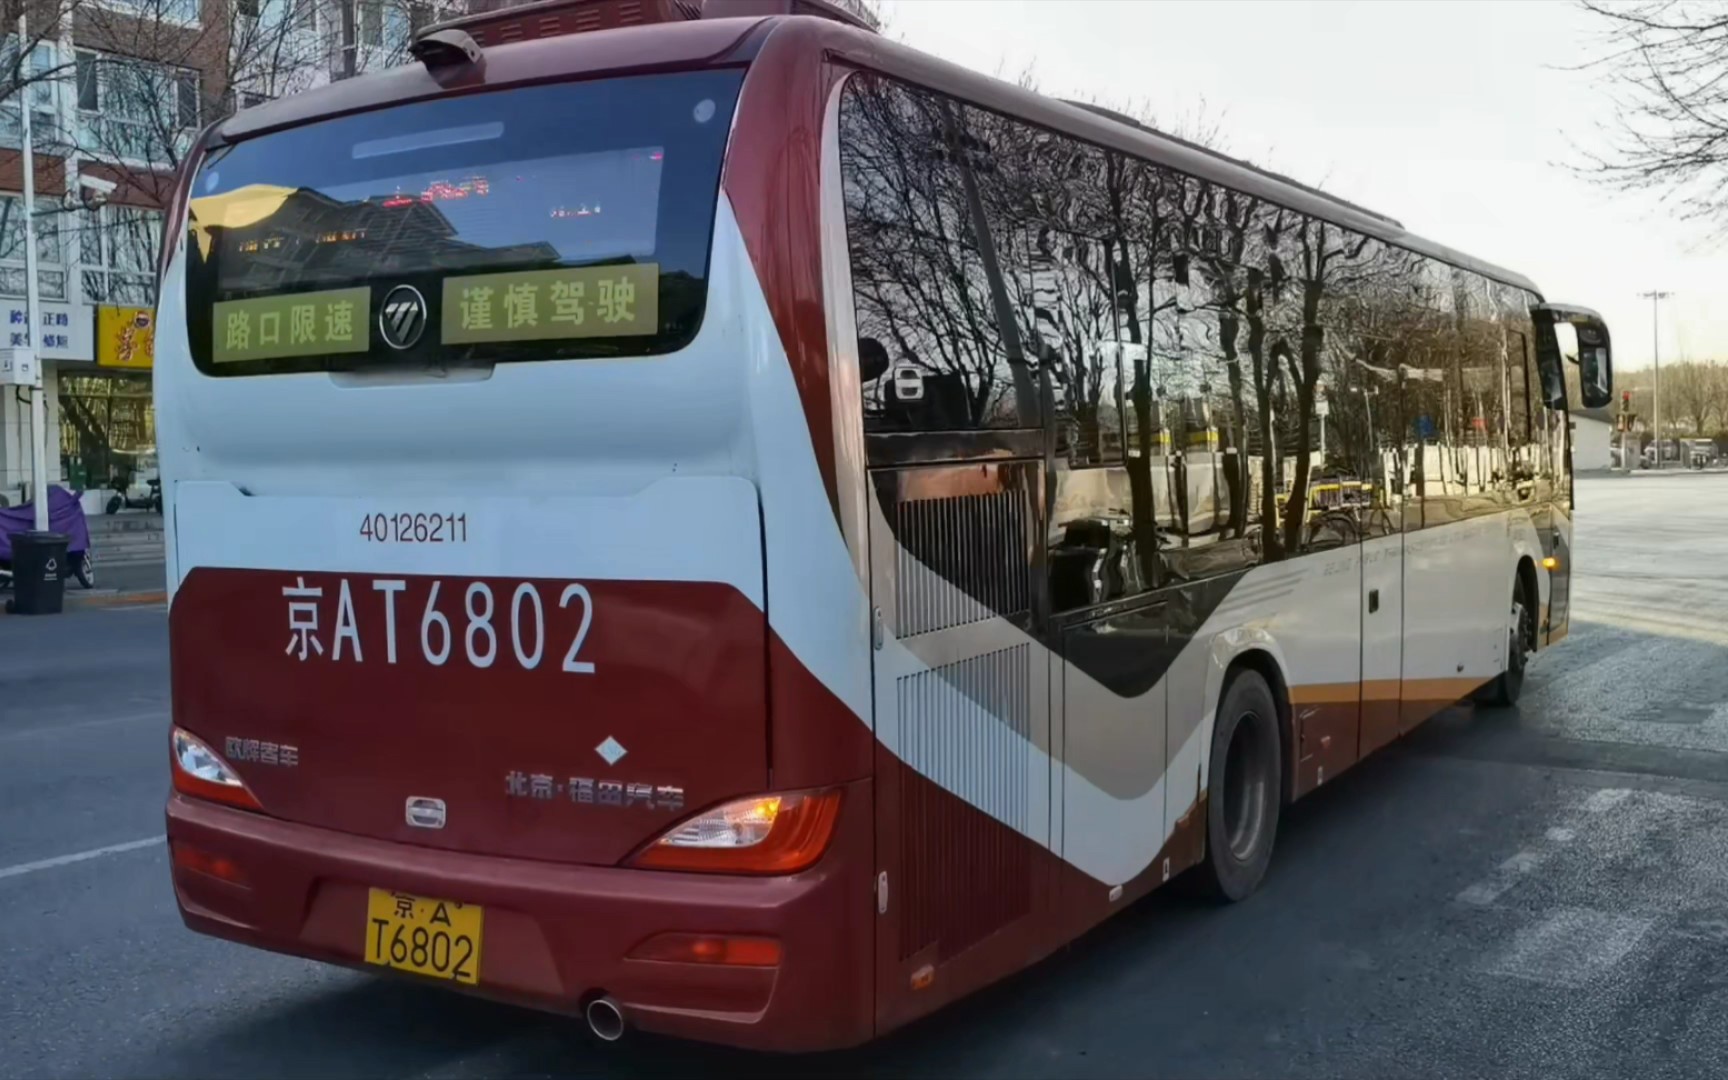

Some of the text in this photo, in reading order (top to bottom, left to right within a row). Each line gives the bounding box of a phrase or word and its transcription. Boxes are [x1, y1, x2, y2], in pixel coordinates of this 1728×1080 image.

[225, 300, 354, 350] 路口限速
[459, 275, 637, 330] 谨慎驾驶
[359, 512, 468, 543] 40126211
[281, 576, 596, 674] 京AT6802
[225, 736, 299, 767] 欧辉客车
[371, 917, 474, 978] T6802
